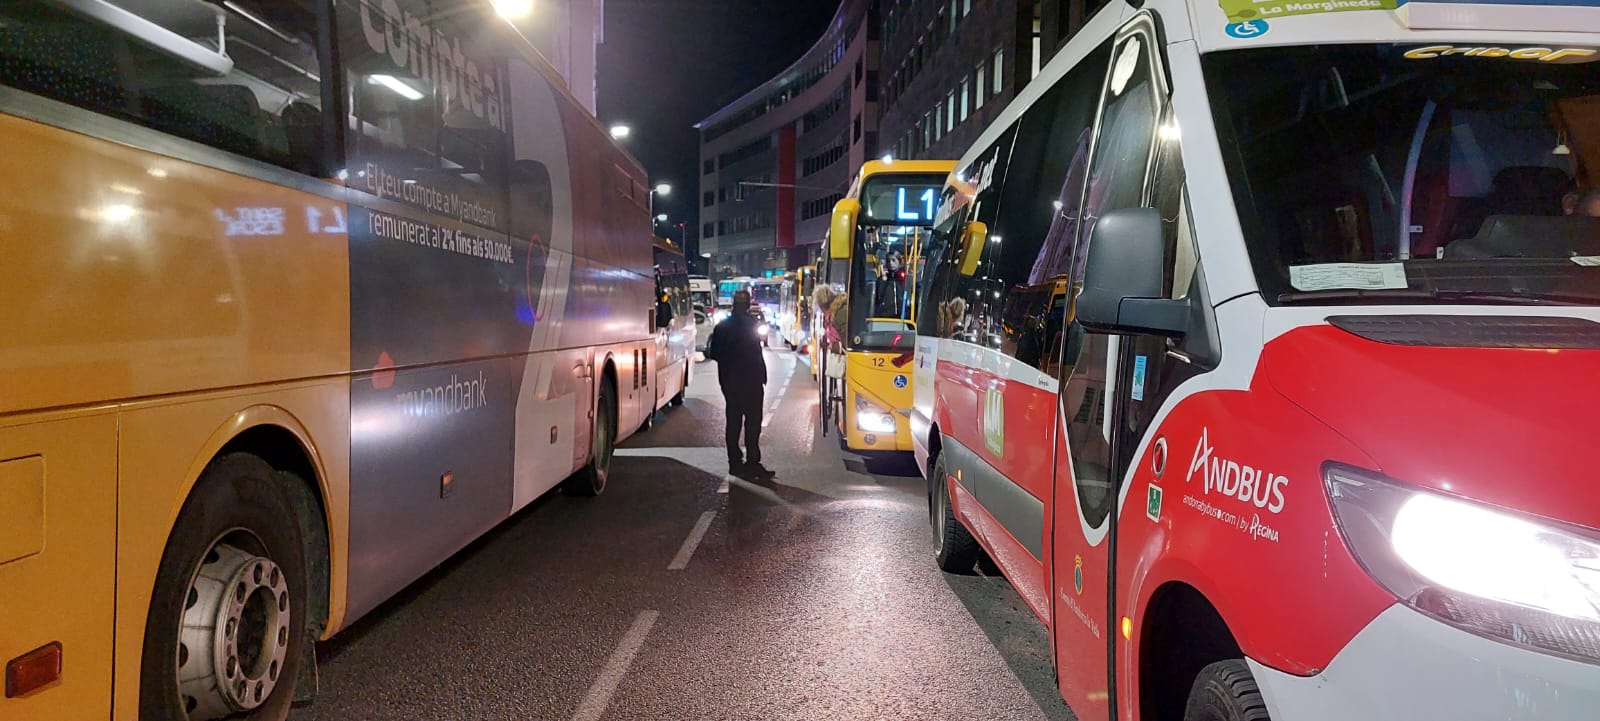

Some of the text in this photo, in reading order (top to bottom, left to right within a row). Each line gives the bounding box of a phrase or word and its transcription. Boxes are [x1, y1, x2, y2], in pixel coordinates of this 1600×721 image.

[1259, 0, 1381, 15] La Margineda
[366, 162, 497, 227] El teu compte a Myandbank
[898, 187, 934, 220] L1
[368, 212, 431, 246] remunerat
[431, 224, 441, 249] al
[442, 229, 454, 252] 2%
[455, 230, 472, 256] fins
[472, 236, 484, 258] als
[872, 357, 885, 367] 12
[396, 370, 487, 417] myandbank
[1186, 426, 1289, 514] ANDBUS
[1240, 516, 1250, 534] by
